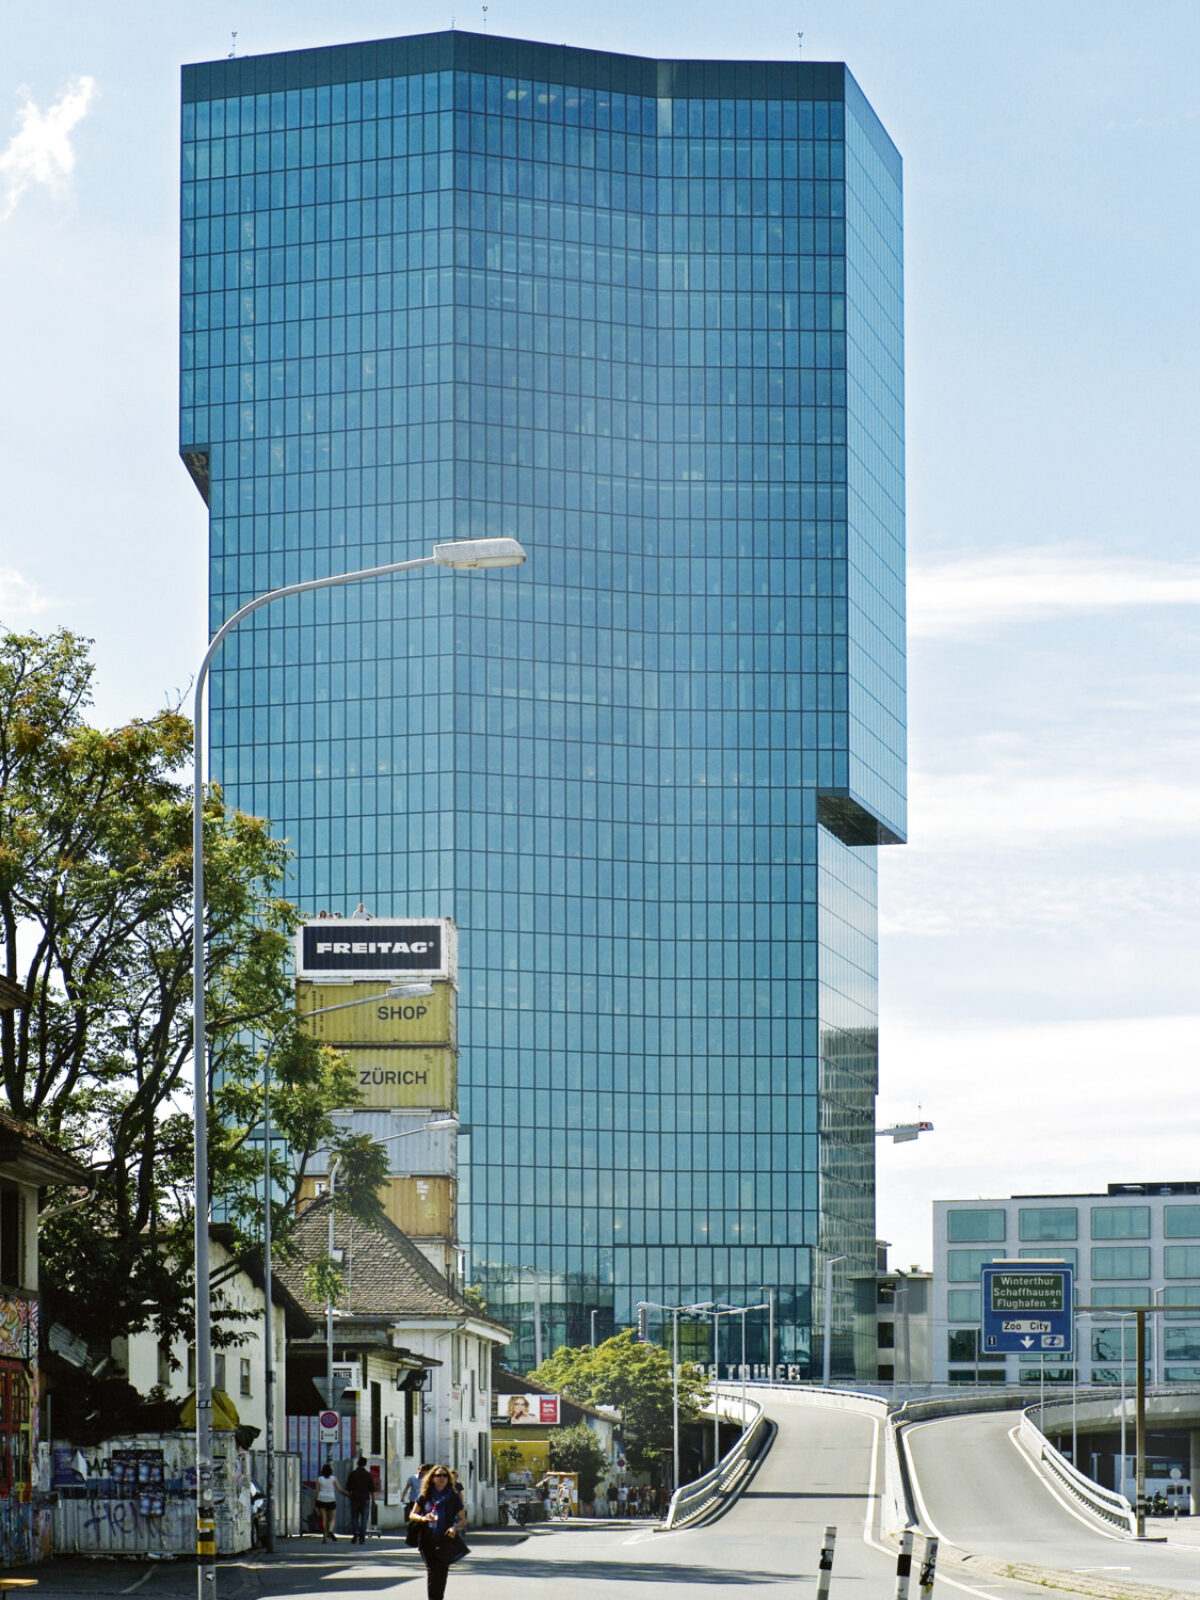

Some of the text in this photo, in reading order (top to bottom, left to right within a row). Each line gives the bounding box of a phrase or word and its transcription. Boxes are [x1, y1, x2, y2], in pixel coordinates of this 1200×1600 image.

[316, 942, 428, 954] FREITAG
[378, 1006, 427, 1020] SHOP
[359, 1067, 427, 1085] ZÜRICH
[1000, 1276, 1055, 1285] Winterthur
[993, 1287, 1062, 1296] Schaffhausen
[996, 1298, 1046, 1309] Flughafen
[1004, 1322, 1049, 1332] Zoo City
